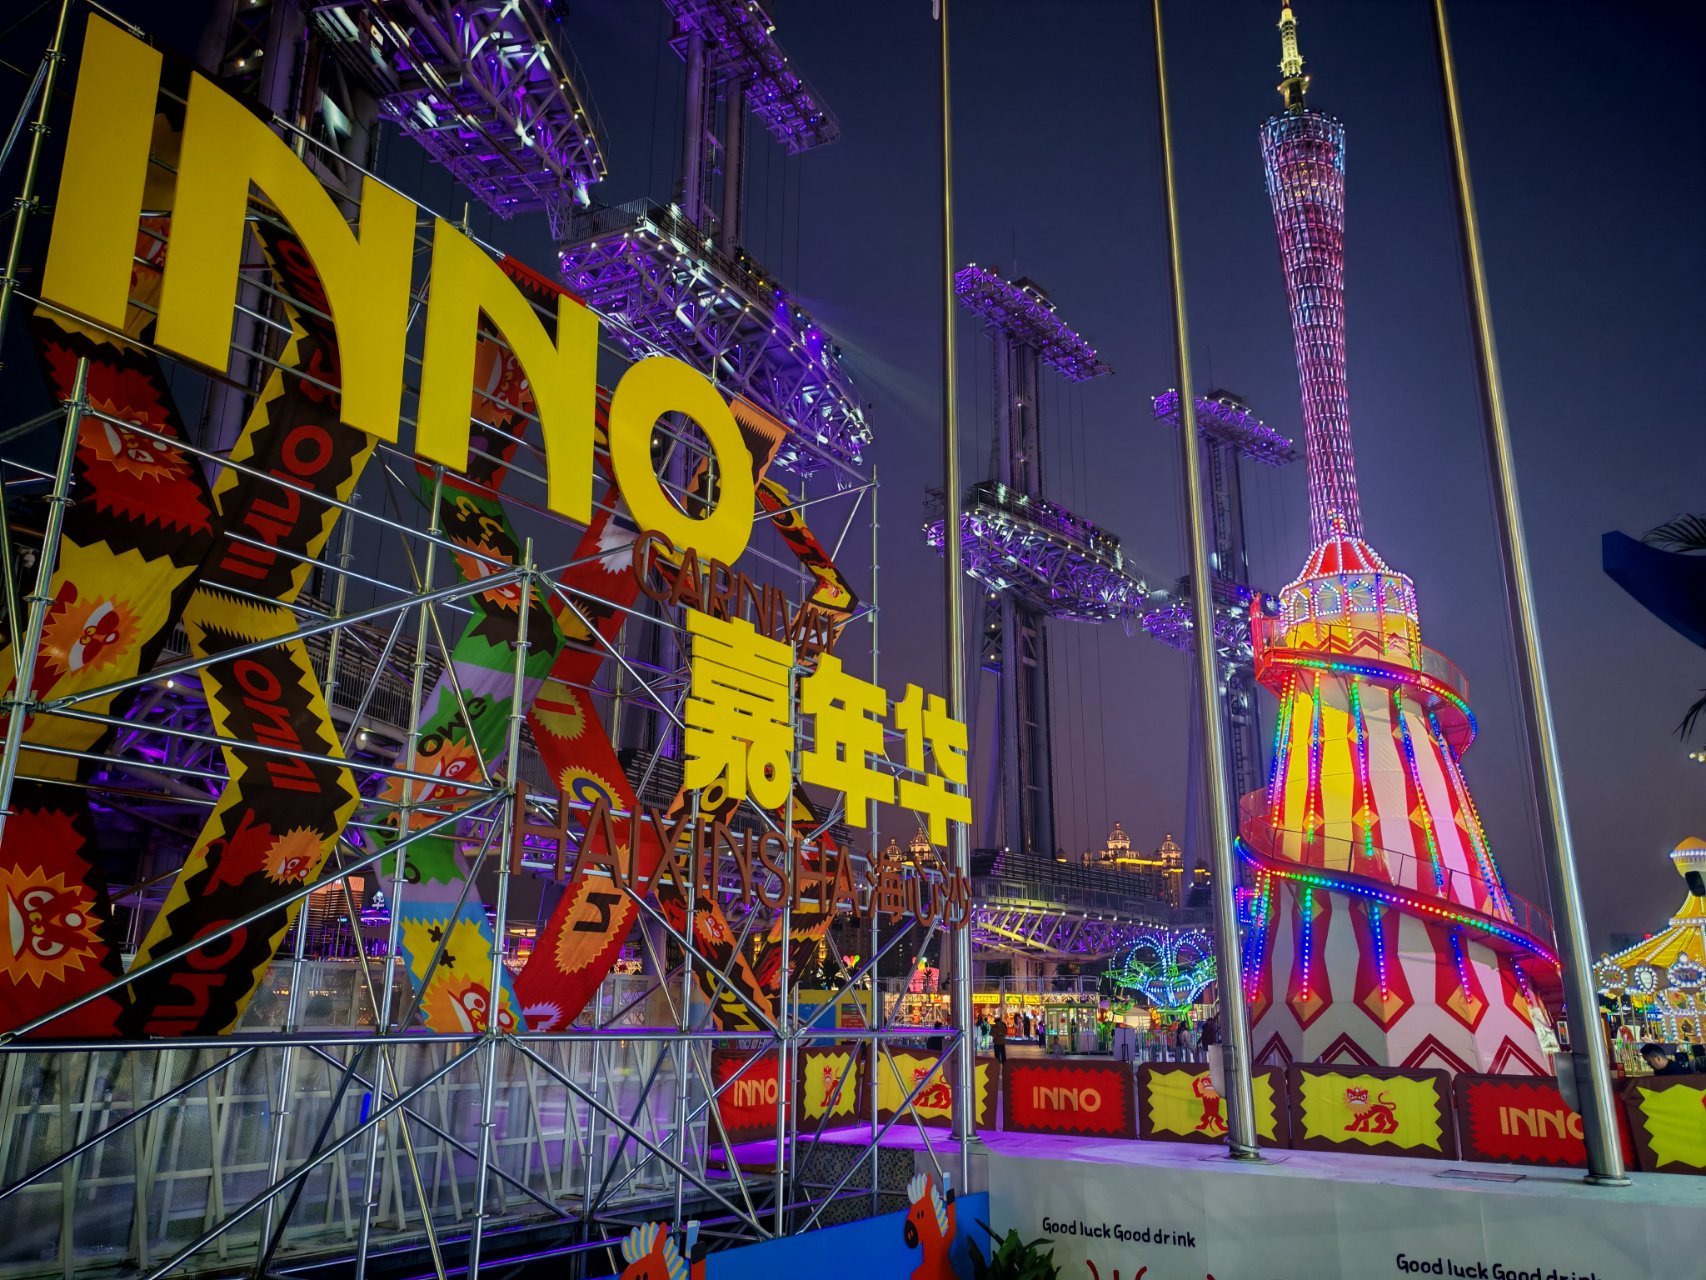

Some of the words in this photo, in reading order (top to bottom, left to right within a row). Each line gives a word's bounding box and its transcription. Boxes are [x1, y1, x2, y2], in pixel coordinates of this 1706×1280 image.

[41, 12, 756, 567] INNO
[219, 425, 333, 580] INNO
[684, 608, 972, 847] 嘉年华
[511, 781, 861, 918] HAIXINSHA
[733, 1077, 779, 1107] INNO
[1032, 1086, 1101, 1113] INNO
[1042, 1217, 1077, 1236] Good
[1080, 1221, 1111, 1239] luck
[1114, 1224, 1150, 1243] Good
[1153, 1228, 1196, 1248] drink
[1396, 1253, 1443, 1275] Good
[1447, 1259, 1488, 1280] luck
[1492, 1263, 1541, 1280] Good
